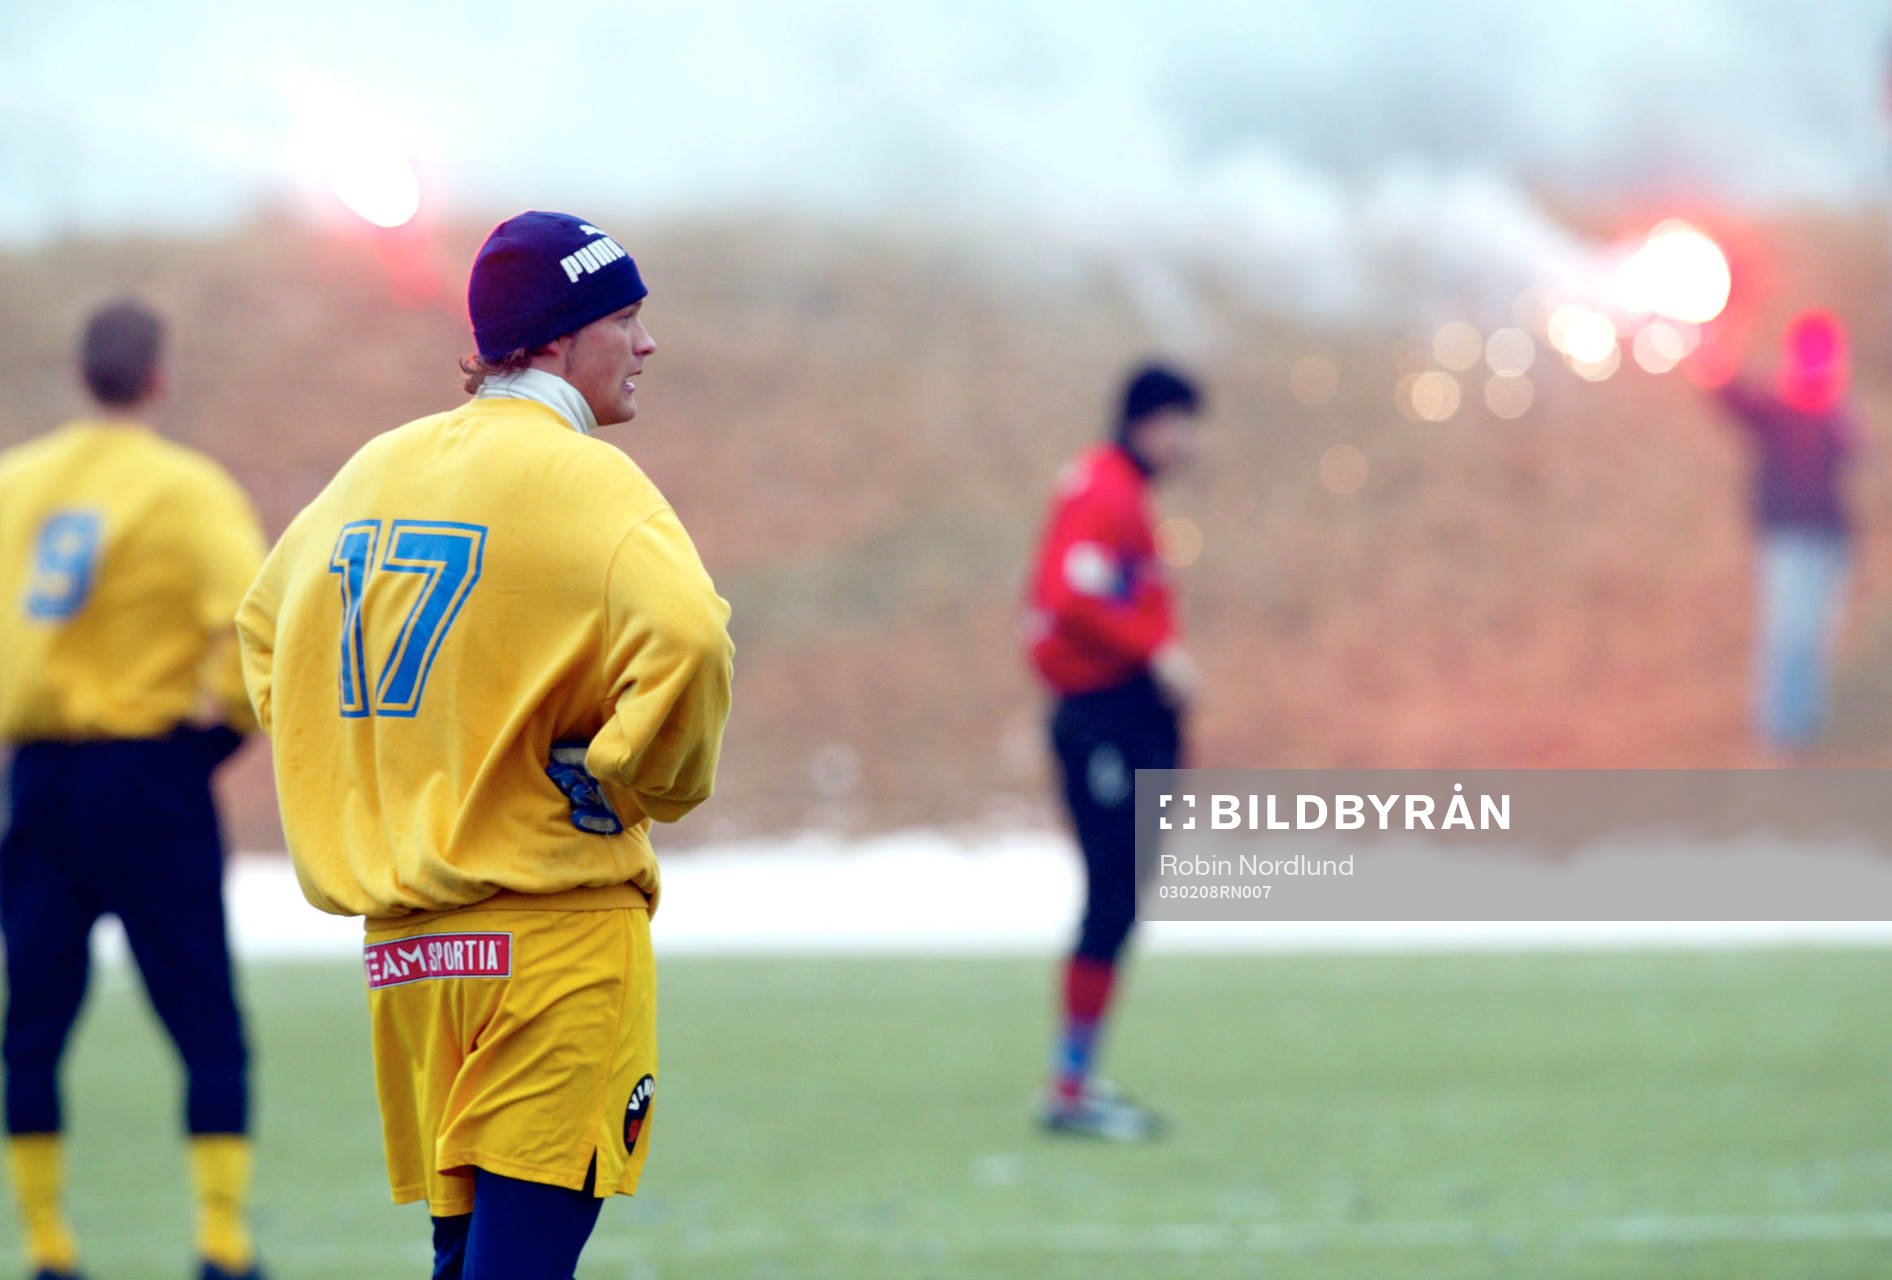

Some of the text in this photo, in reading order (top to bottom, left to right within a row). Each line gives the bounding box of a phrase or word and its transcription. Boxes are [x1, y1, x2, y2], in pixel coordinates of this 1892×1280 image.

[27, 511, 102, 621] 9
[329, 519, 488, 718] 17
[428, 940, 499, 972] SPORTIA
